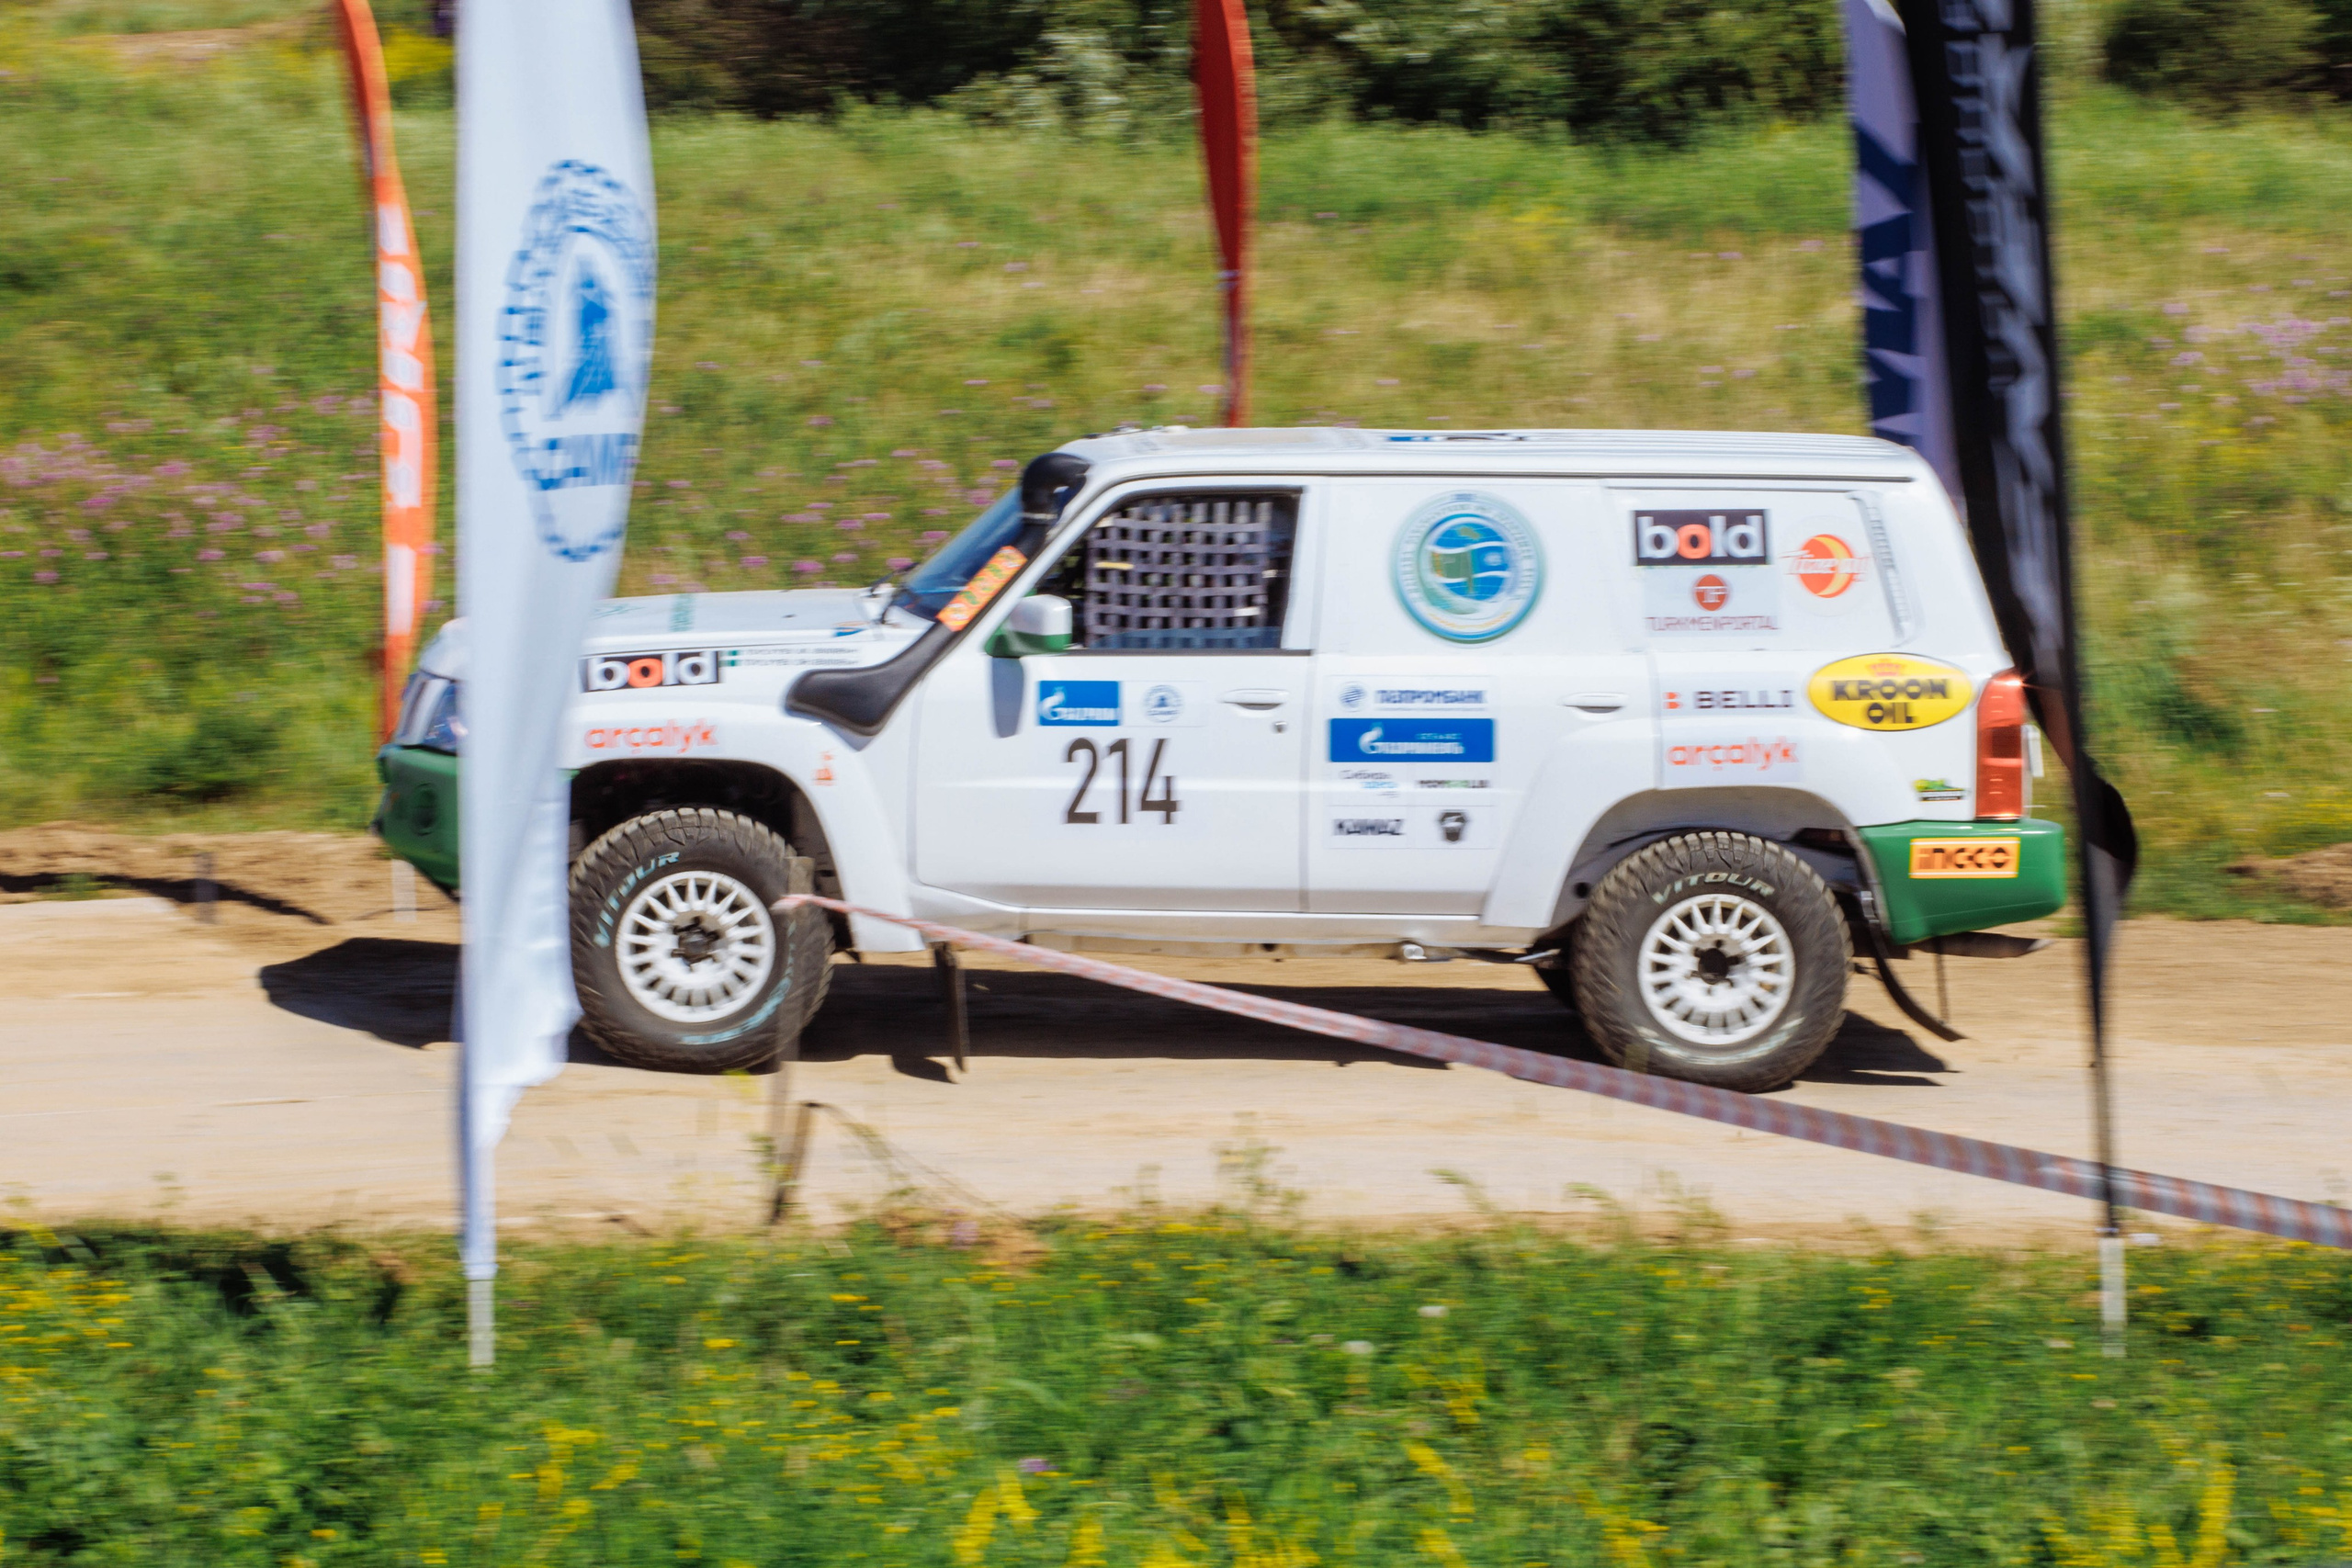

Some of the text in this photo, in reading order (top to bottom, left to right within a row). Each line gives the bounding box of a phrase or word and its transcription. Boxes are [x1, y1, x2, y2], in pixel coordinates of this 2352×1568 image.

[1637, 513, 1765, 558] bold
[587, 650, 716, 690] bold
[1693, 689, 1794, 709] BELLI
[1831, 678, 1951, 701] KROON
[1866, 702, 1917, 724] OIL
[1062, 738, 1182, 825] 214
[1651, 871, 1776, 905] VITOUR
